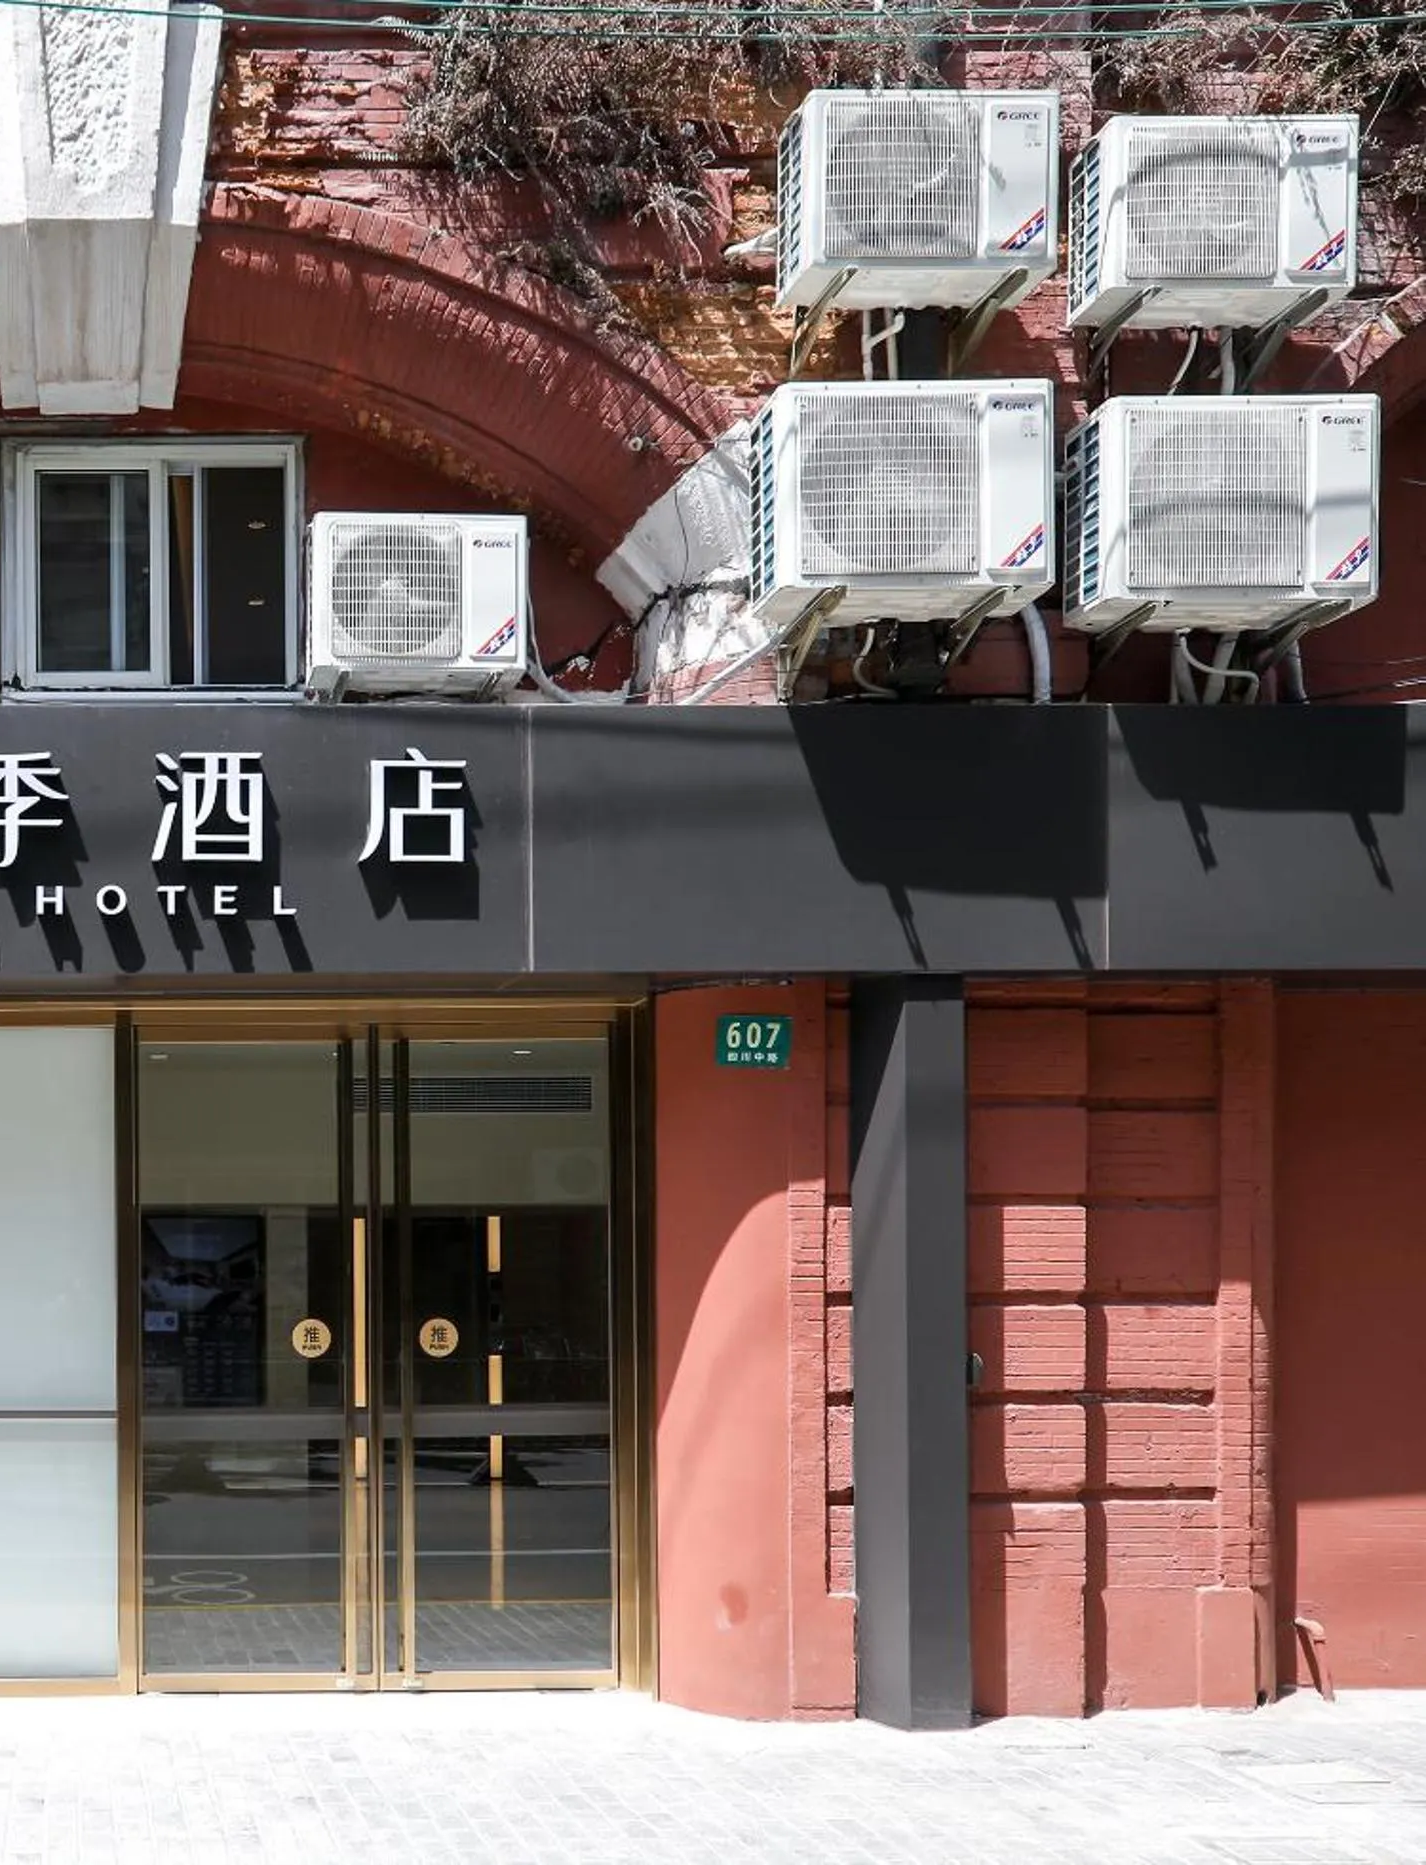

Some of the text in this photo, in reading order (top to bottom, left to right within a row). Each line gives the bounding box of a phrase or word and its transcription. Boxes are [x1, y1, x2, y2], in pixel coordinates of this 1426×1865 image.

[35, 885, 297, 915] HOTEL
[726, 1022, 782, 1049] 607
[303, 1325, 320, 1343] 推
[430, 1324, 447, 1343] 推
